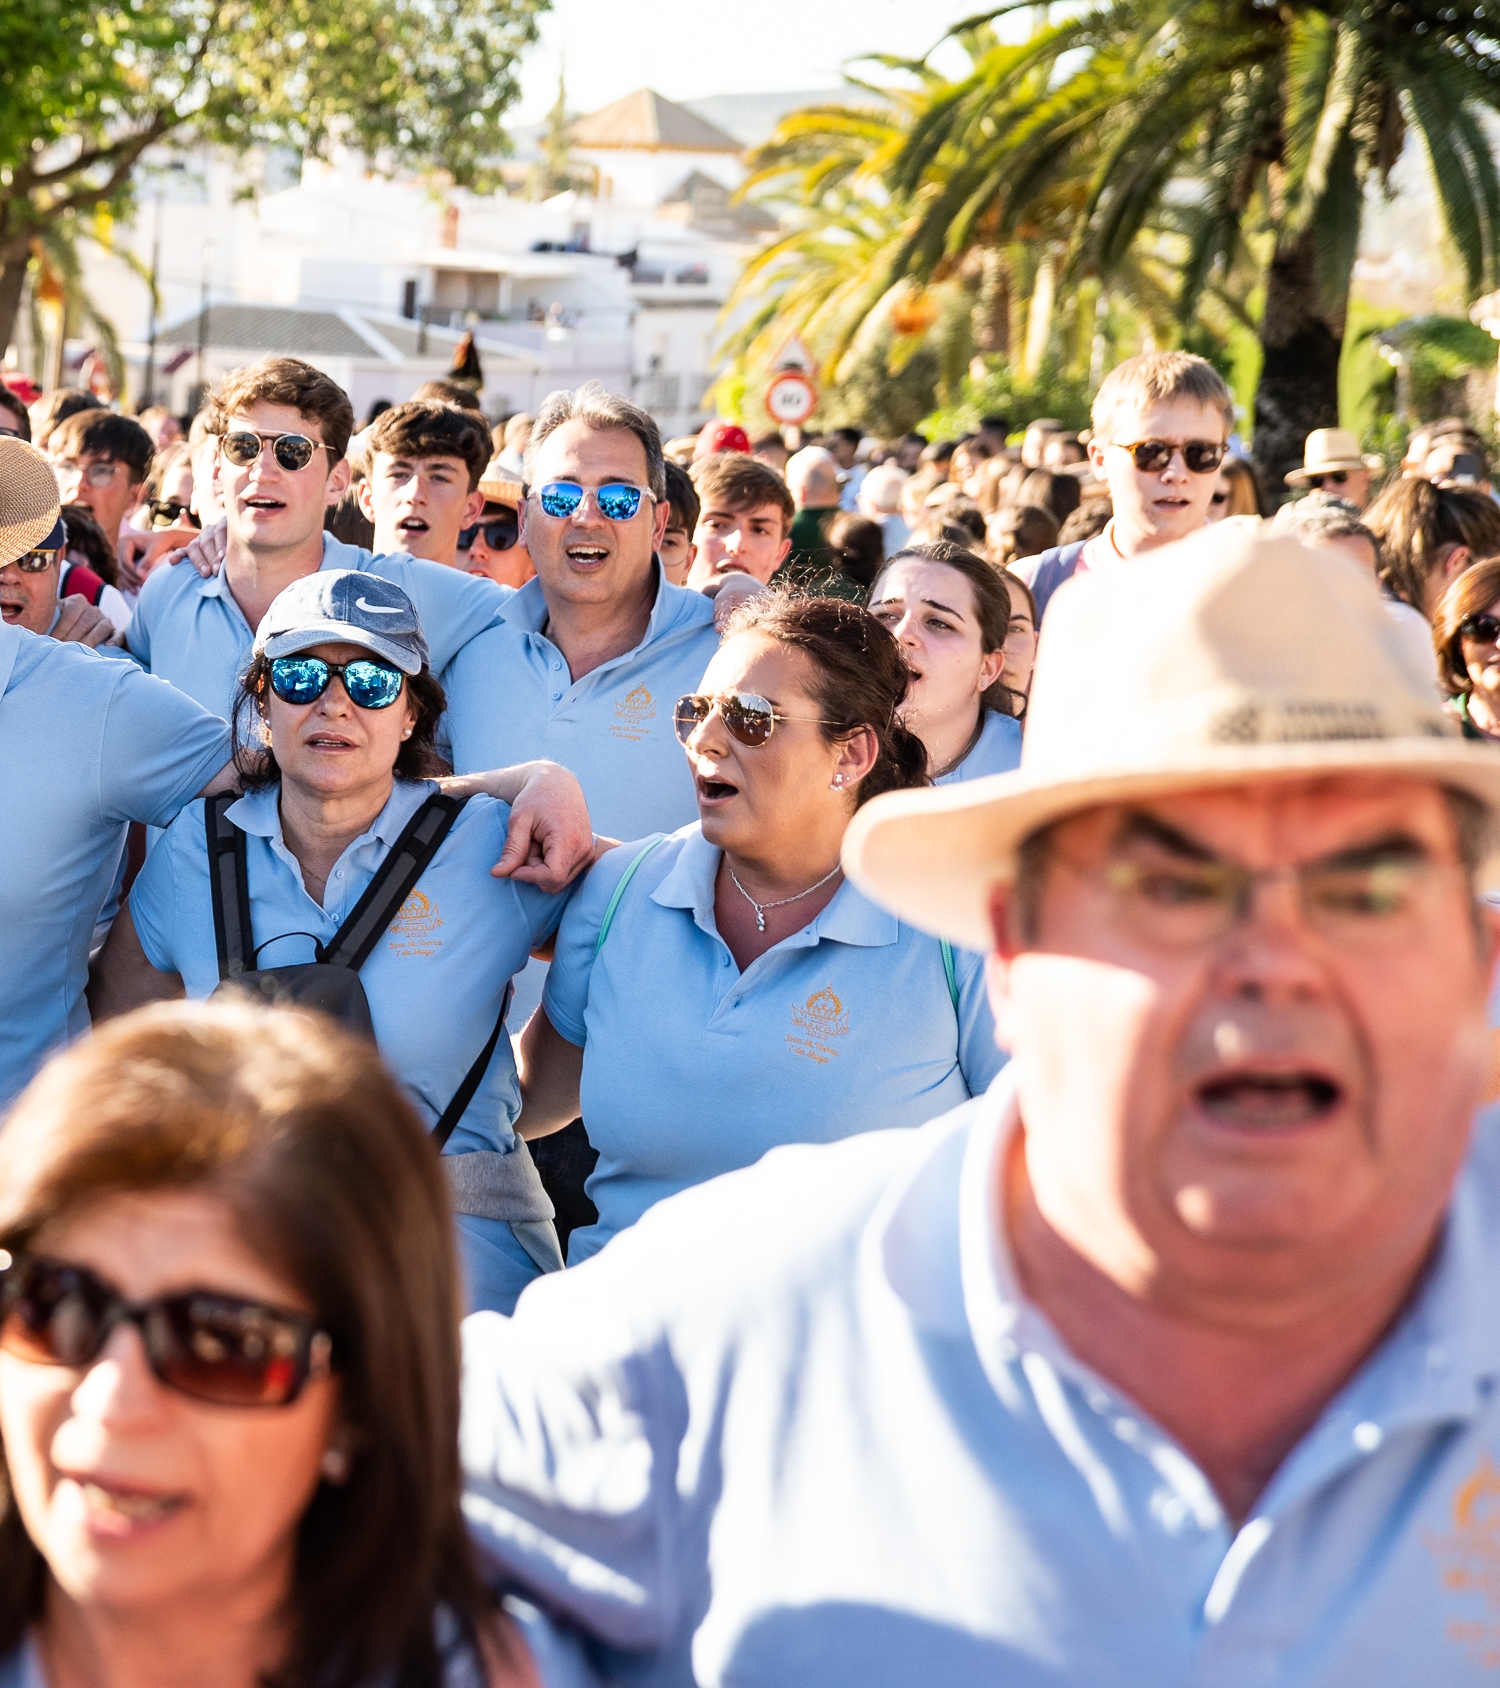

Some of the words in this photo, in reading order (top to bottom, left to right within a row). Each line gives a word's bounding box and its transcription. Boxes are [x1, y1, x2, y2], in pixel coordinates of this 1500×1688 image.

[805, 1029, 828, 1041] 2023
[795, 1047, 805, 1055] de
[807, 1050, 830, 1064] Mayo
[815, 1041, 840, 1057] Torres
